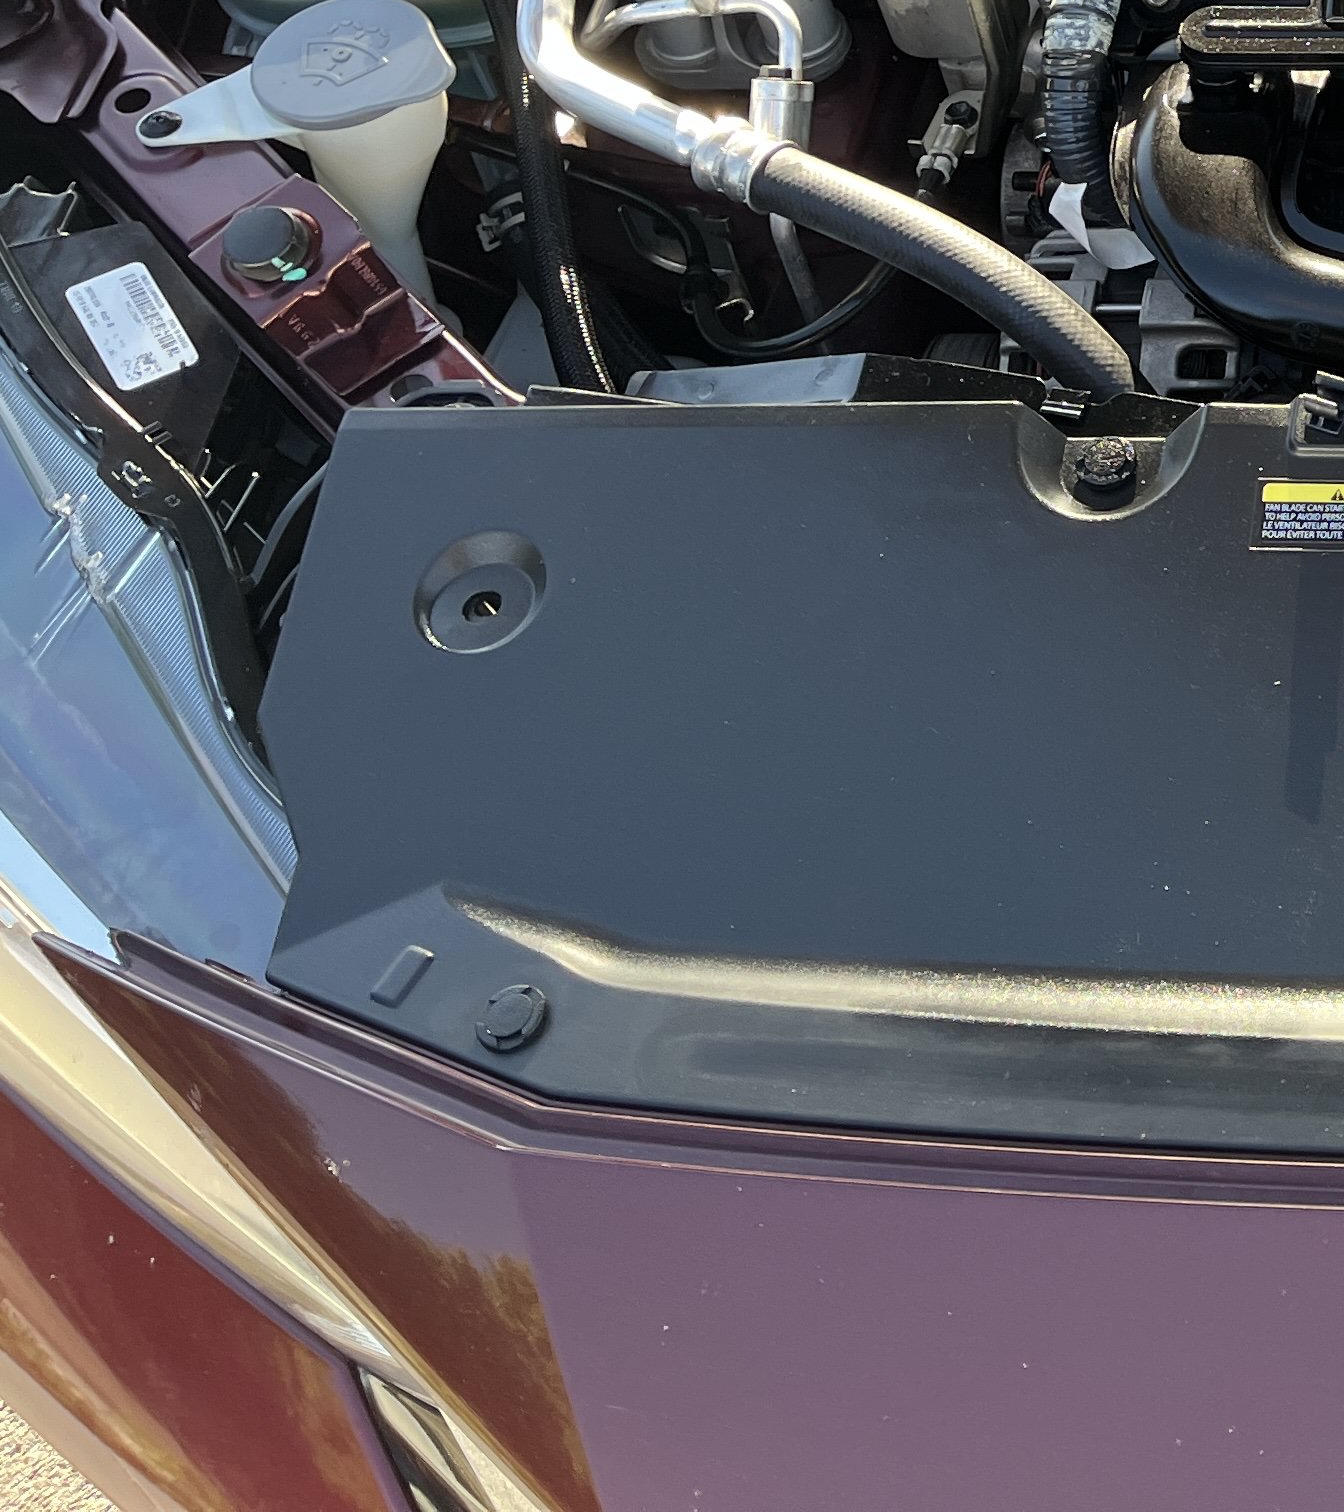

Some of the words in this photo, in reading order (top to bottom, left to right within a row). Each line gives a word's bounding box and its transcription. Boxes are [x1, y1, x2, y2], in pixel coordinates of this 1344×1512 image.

[1265, 504, 1281, 512] FAN
[1281, 504, 1306, 512] BLADE
[1307, 504, 1324, 512] CAN
[1265, 513, 1276, 521] TO
[1277, 513, 1296, 521] HELP
[1297, 513, 1321, 521] AVOID
[1263, 522, 1273, 530] LE
[1274, 522, 1328, 530] VENTILATEUR
[1262, 531, 1286, 539] POUR
[1316, 531, 1343, 539] TOUTE
